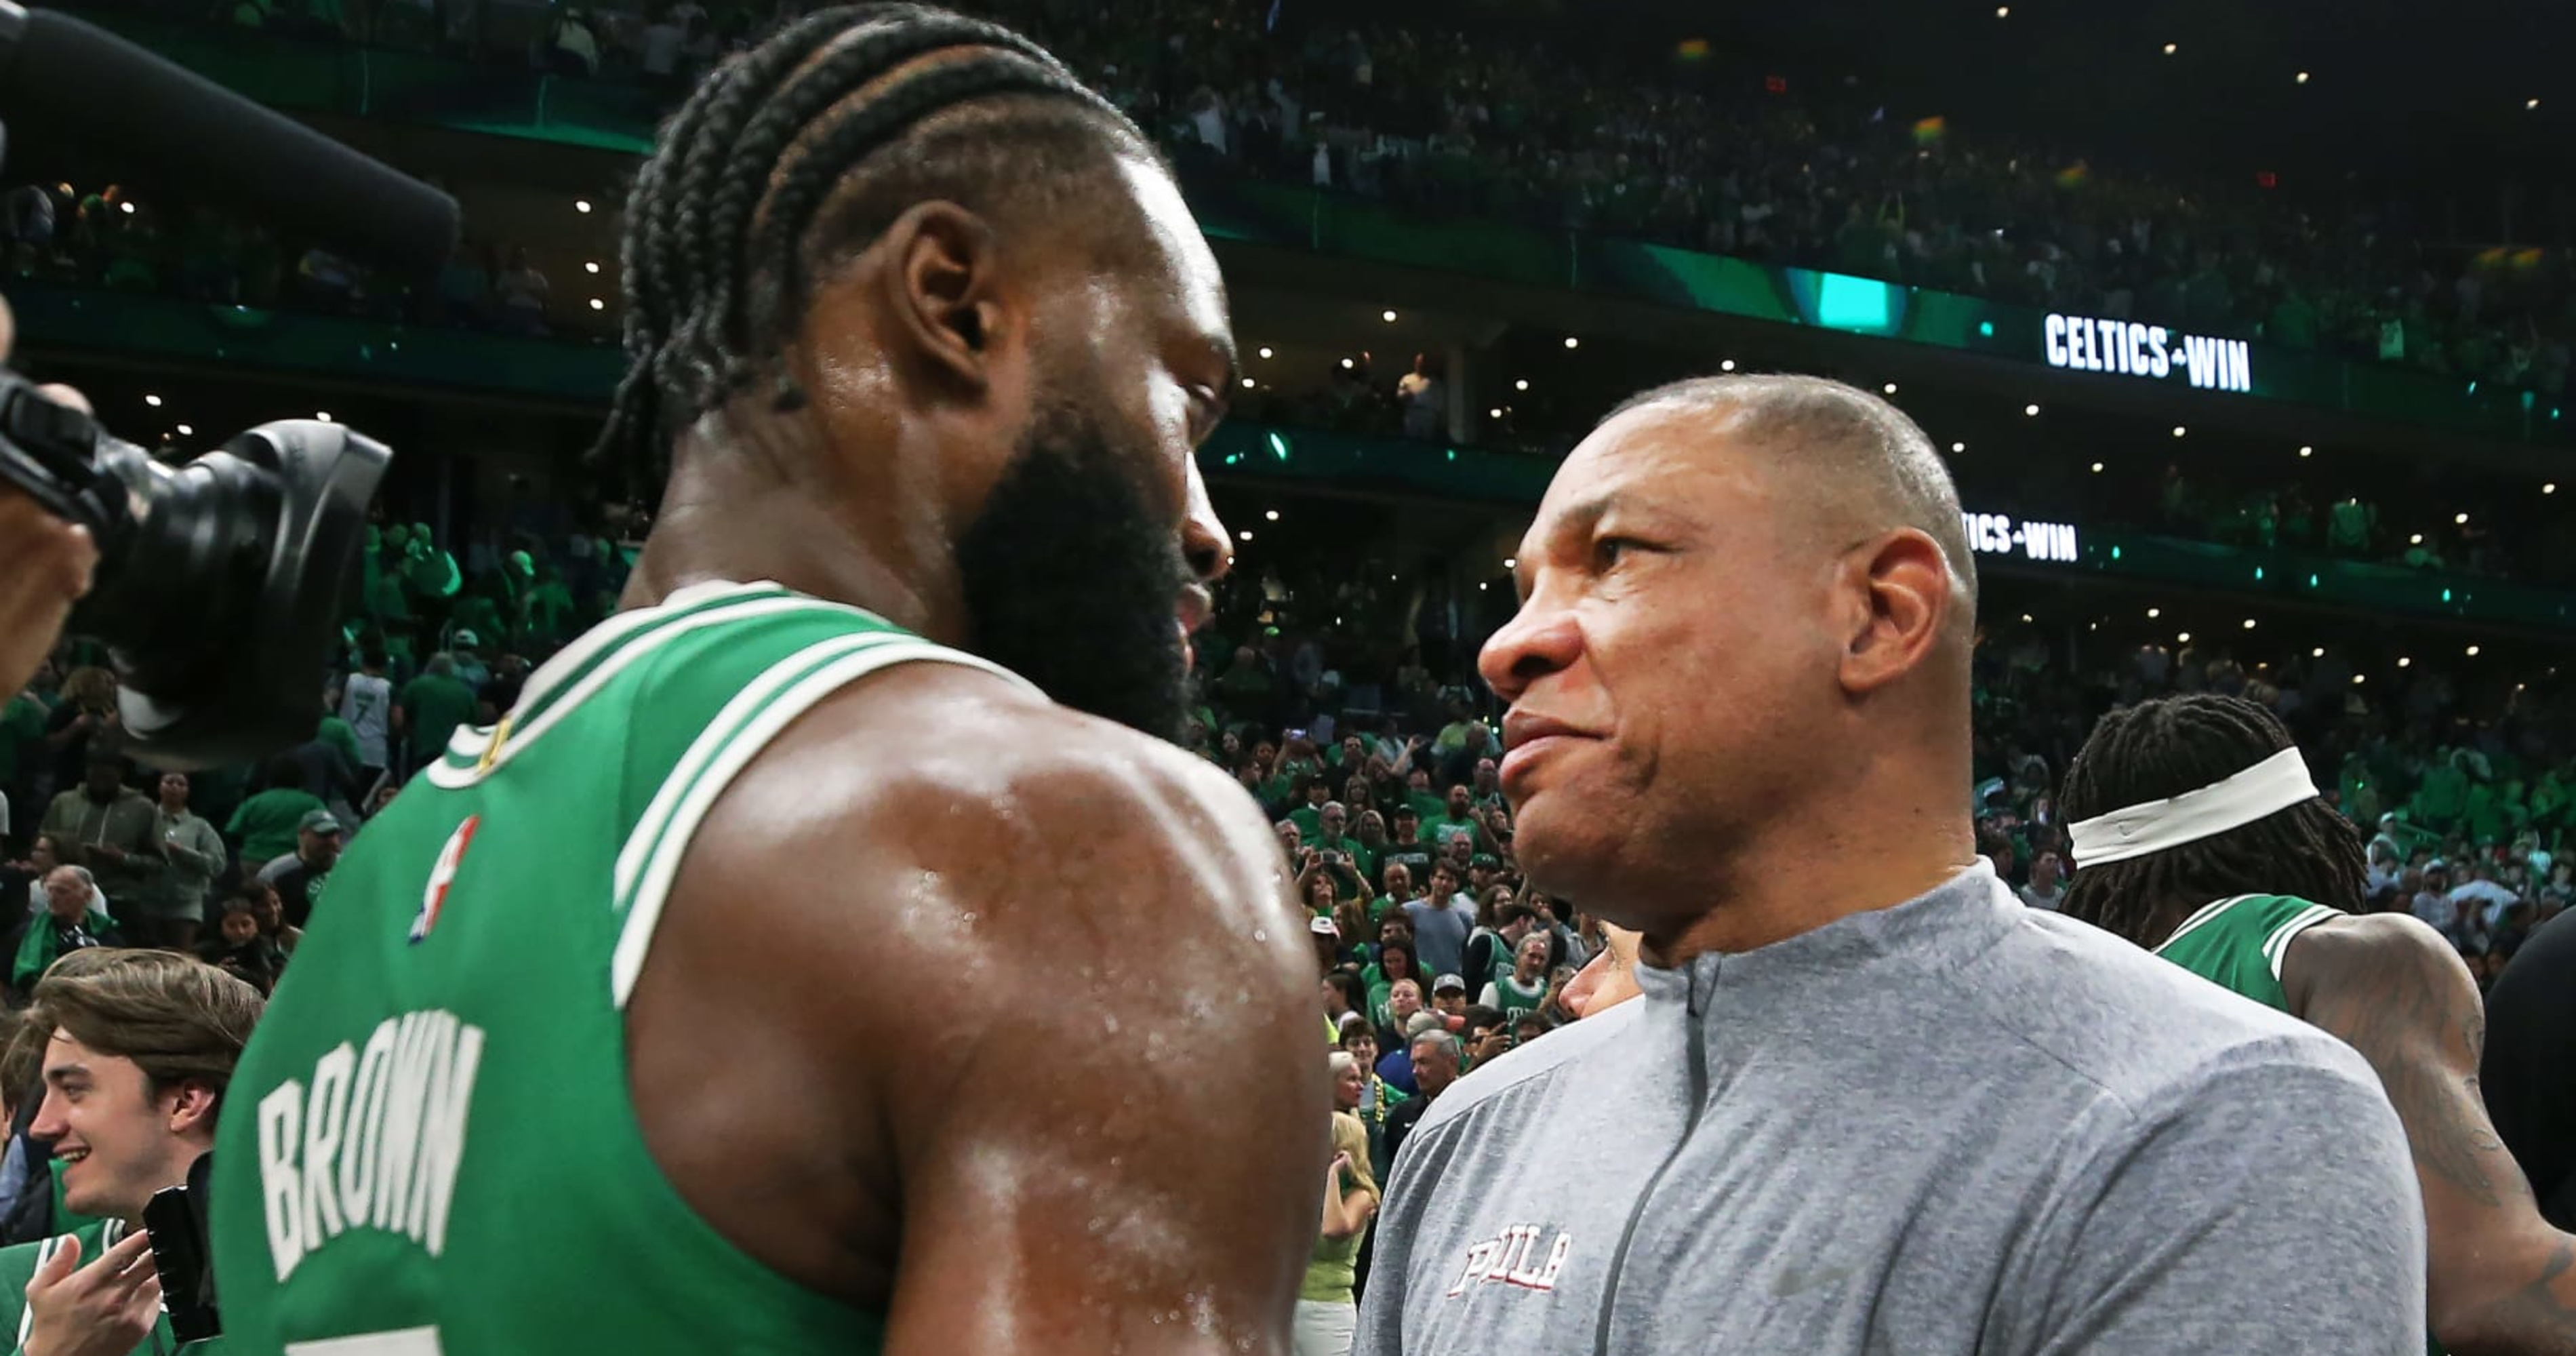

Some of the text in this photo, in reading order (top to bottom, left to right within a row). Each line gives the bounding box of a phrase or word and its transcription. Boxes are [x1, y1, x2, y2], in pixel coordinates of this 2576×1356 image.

[2045, 313, 2251, 392] CELTICS WIN
[2022, 521, 2078, 562] WIN
[258, 1008, 486, 1282] BROWN
